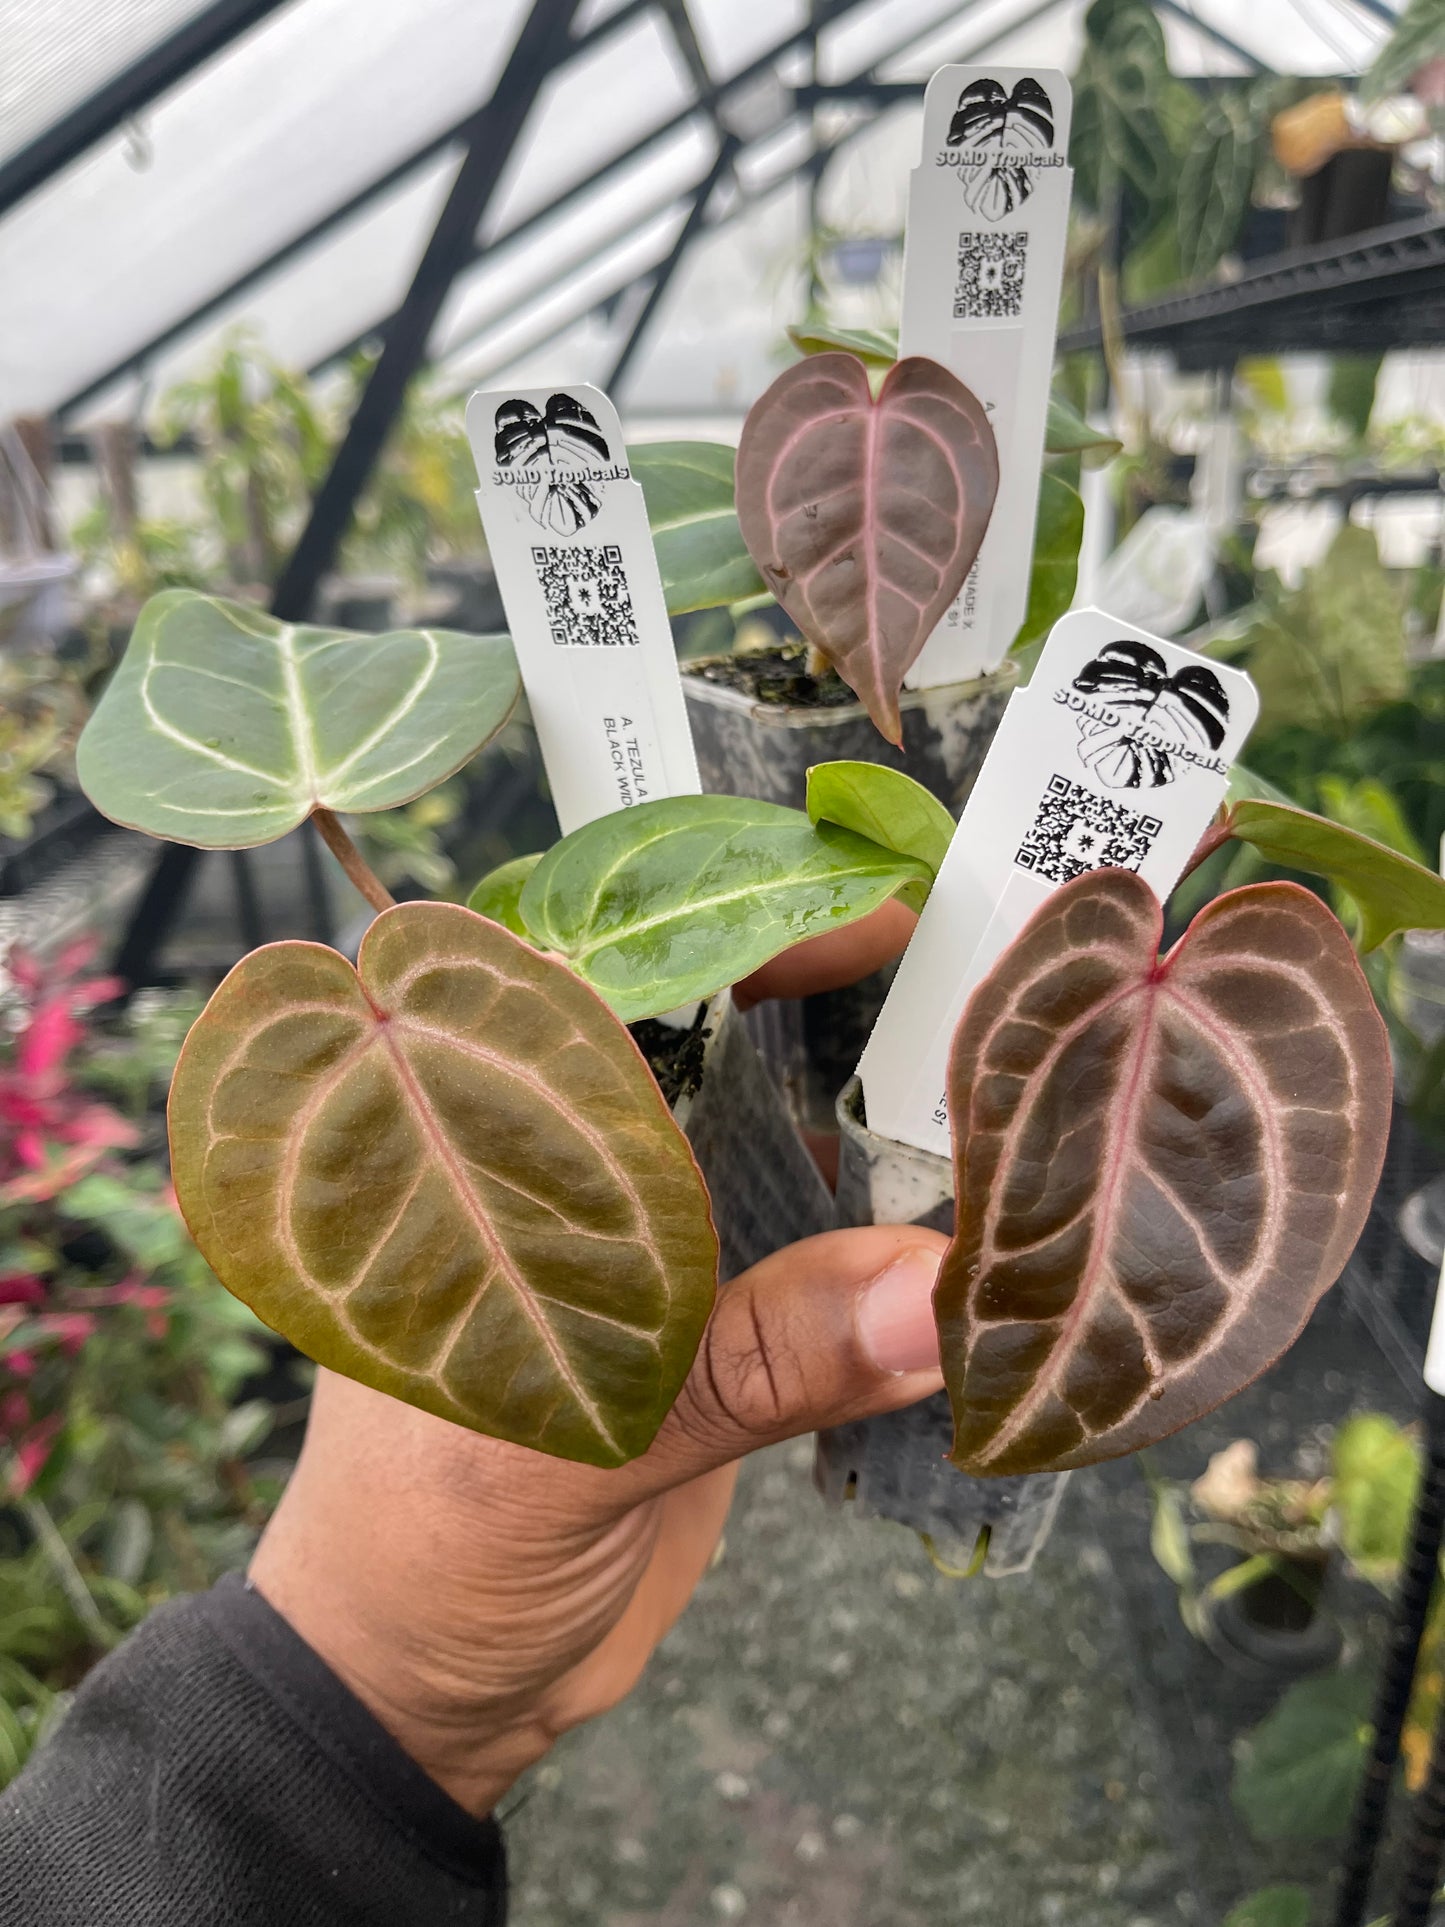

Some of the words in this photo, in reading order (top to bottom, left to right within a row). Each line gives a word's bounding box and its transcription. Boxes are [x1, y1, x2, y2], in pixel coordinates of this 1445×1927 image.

[936, 151, 987, 167] SOMD
[992, 151, 1065, 168] Tropicals
[545, 464, 630, 483] Tropicals
[620, 716, 633, 731] A.
[1053, 688, 1121, 727] SOMD
[1127, 721, 1230, 776] Tropicals
[603, 717, 626, 772] BLACK
[617, 776, 633, 808] WID
[931, 1109, 947, 1126] S1
